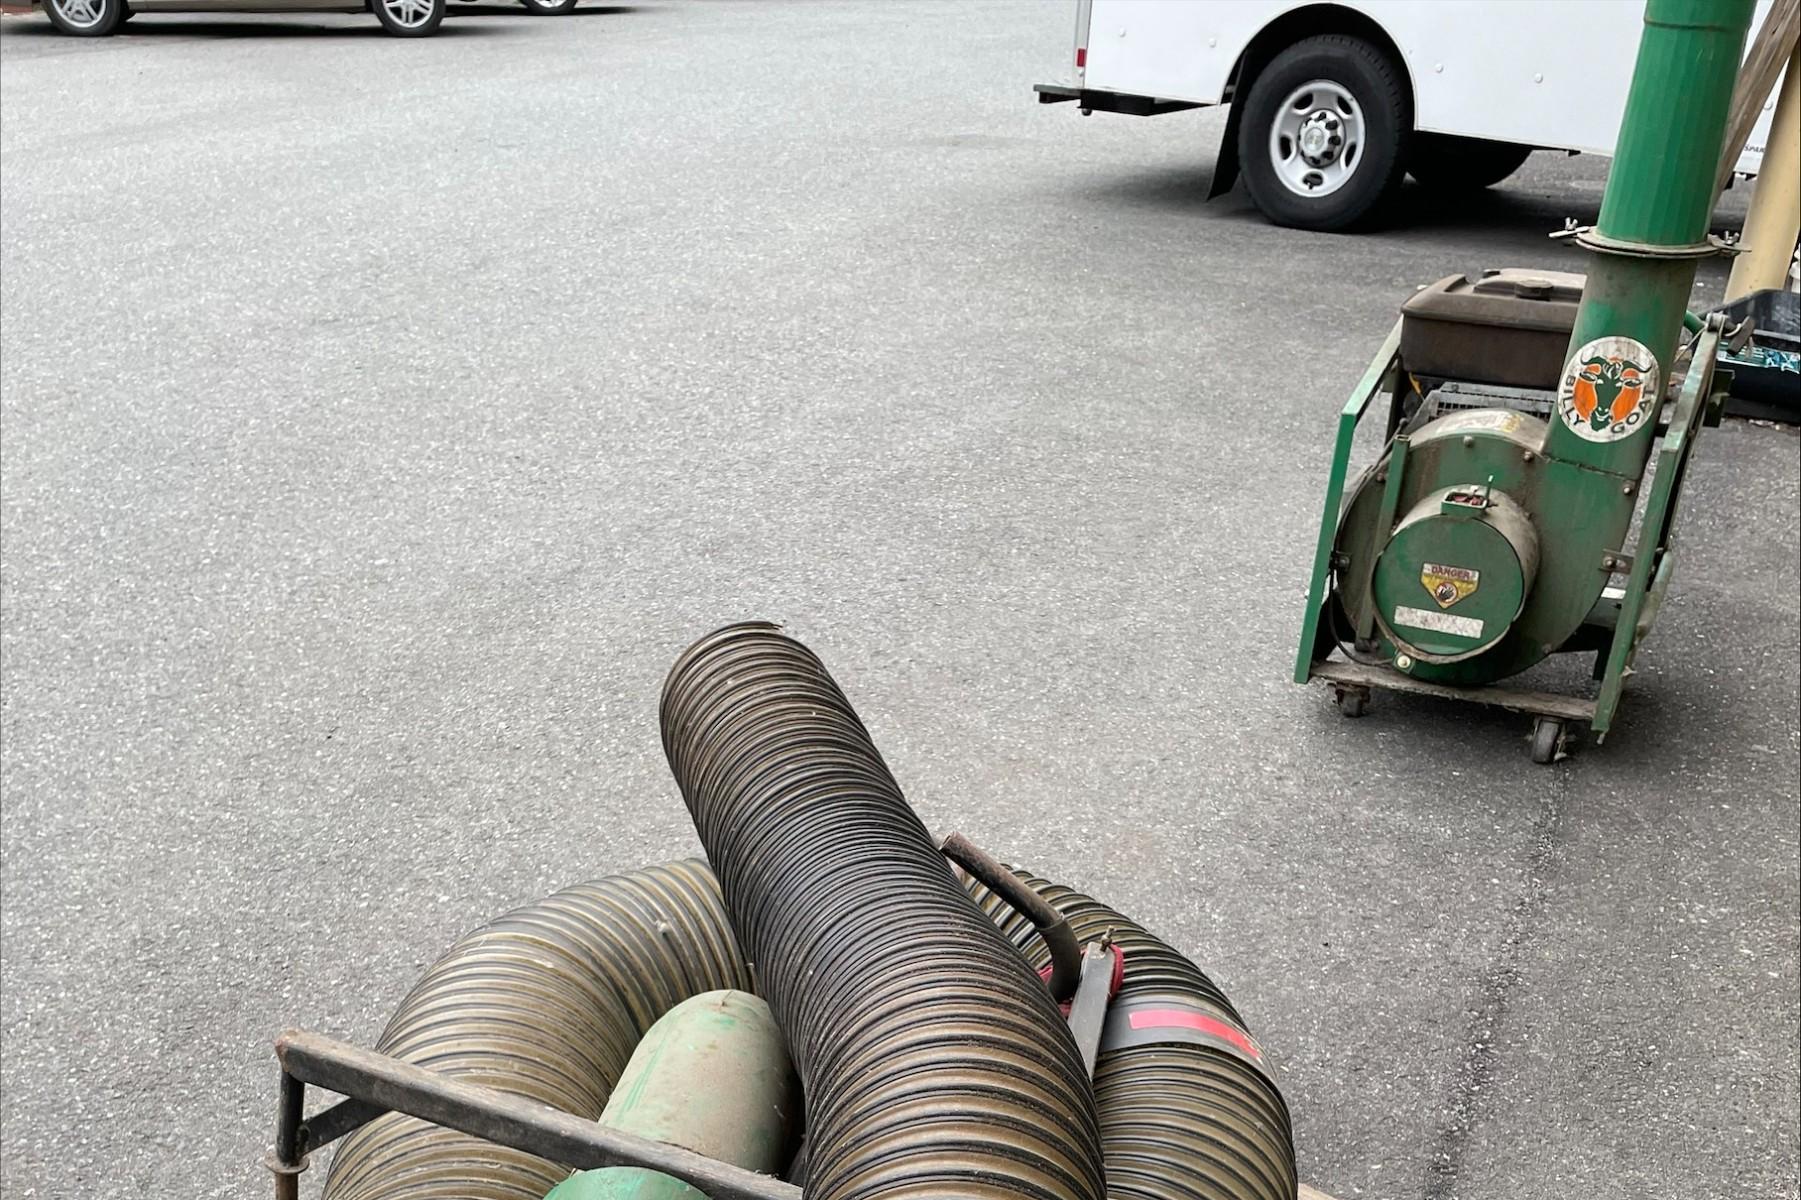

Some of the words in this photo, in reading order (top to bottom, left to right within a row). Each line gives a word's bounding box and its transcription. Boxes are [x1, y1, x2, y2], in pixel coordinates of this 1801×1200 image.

[1562, 374, 1585, 426] BILLY
[1611, 386, 1655, 434] GOAT
[1431, 565, 1470, 581] DANGER
